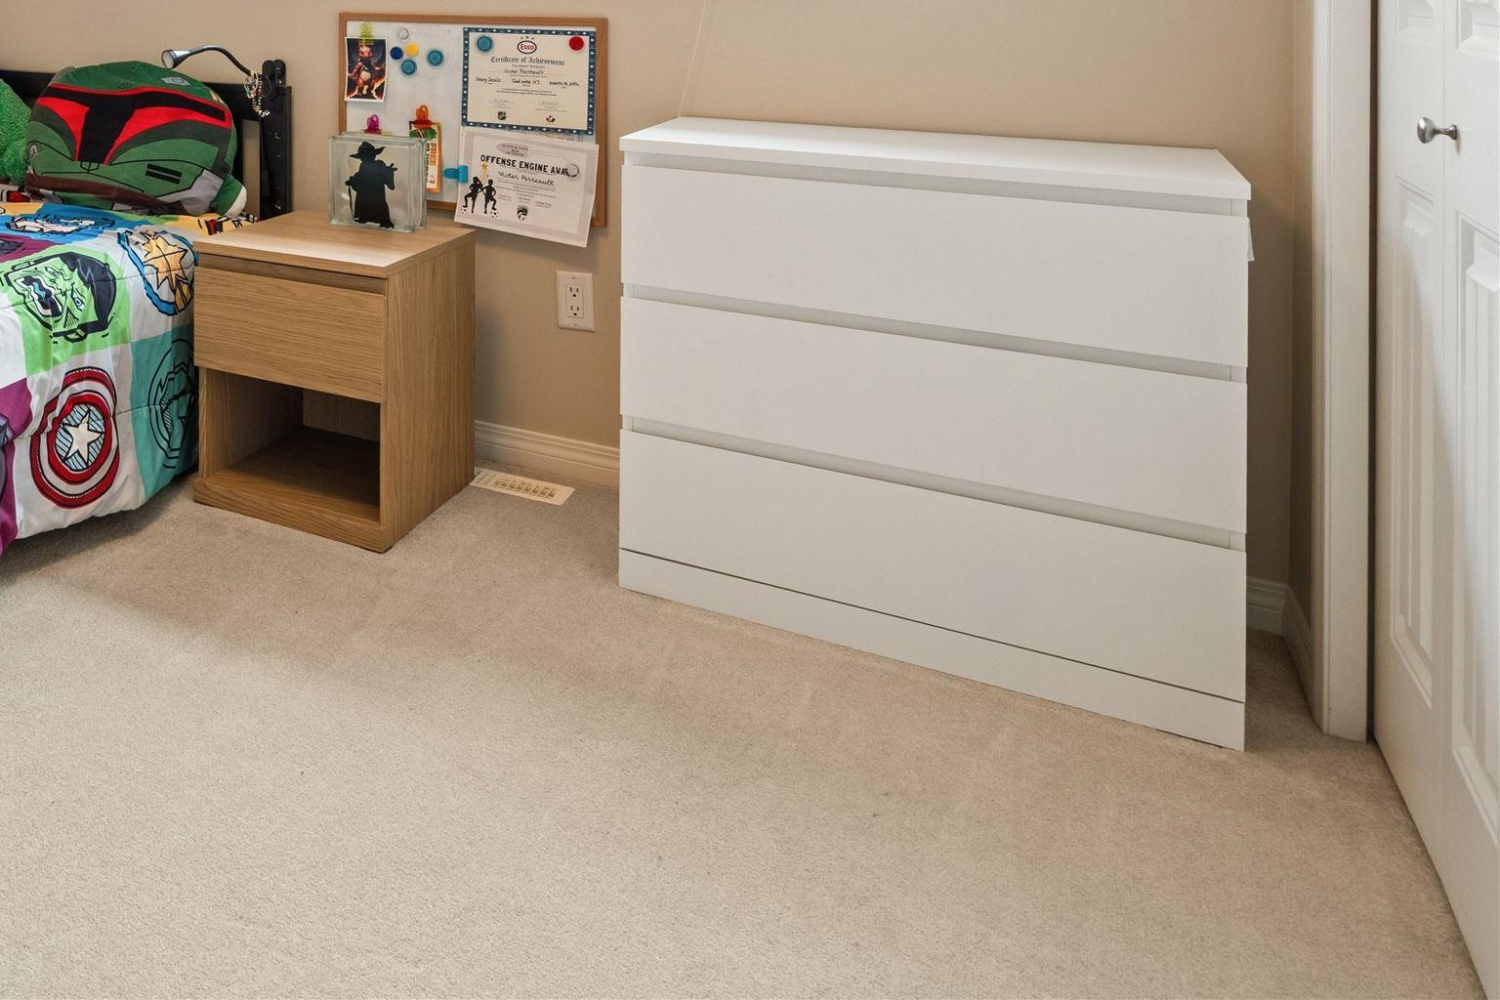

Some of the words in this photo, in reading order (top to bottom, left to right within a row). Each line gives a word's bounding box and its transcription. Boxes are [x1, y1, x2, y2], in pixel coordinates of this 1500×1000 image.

[528, 57, 565, 66] Achievement
[429, 142, 437, 167] FREE
[480, 154, 517, 167] OFFENSE
[519, 160, 548, 173] ENGINE
